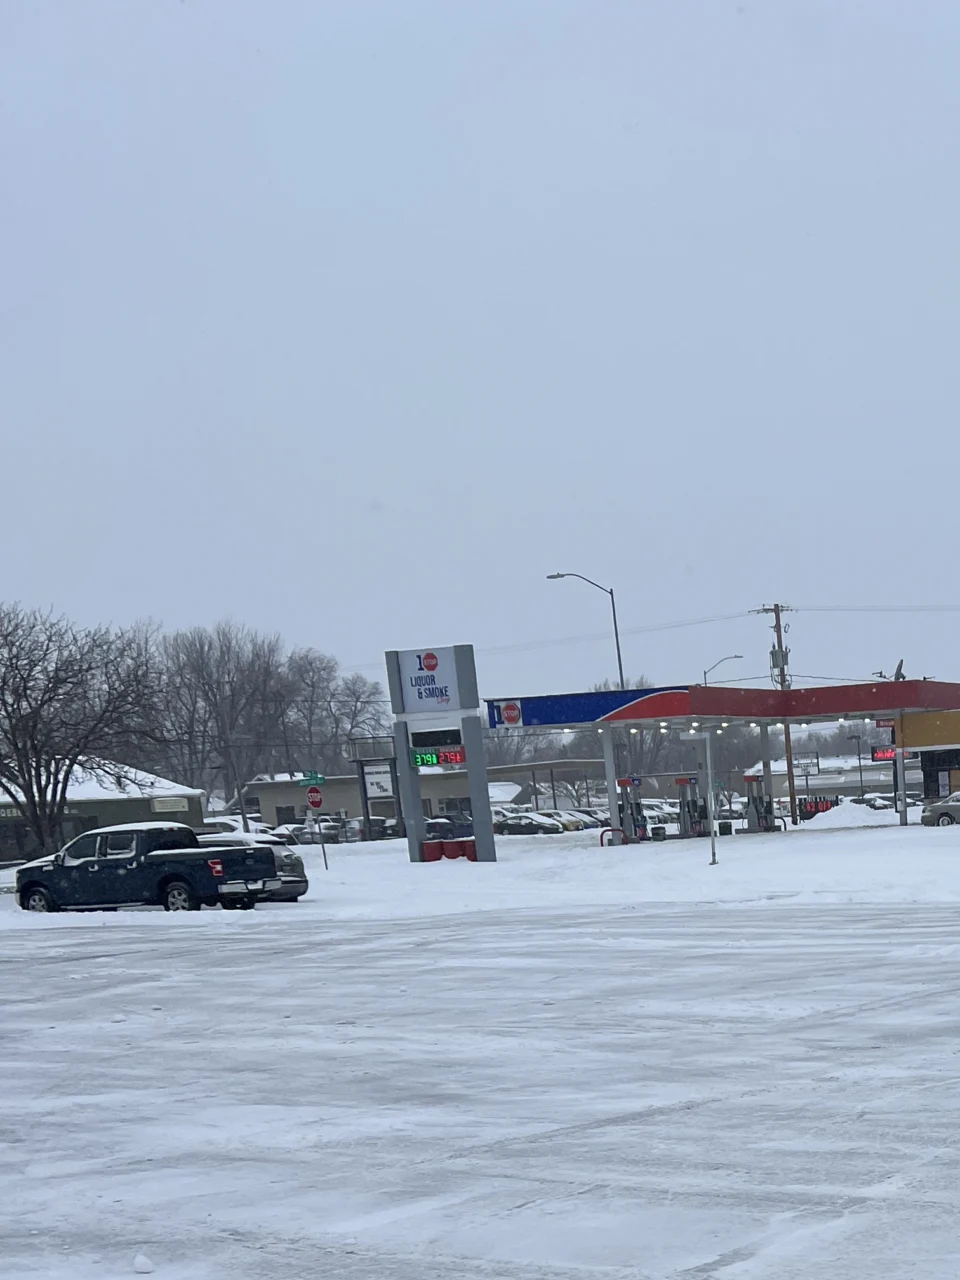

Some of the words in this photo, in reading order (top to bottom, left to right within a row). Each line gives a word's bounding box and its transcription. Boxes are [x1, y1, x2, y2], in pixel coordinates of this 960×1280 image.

[416, 654, 424, 671] 1
[424, 658, 437, 666] STOP
[410, 675, 436, 687] LIQUOR
[424, 686, 449, 699] SMOKE
[504, 710, 519, 718] STOP
[308, 792, 321, 802] STOP
